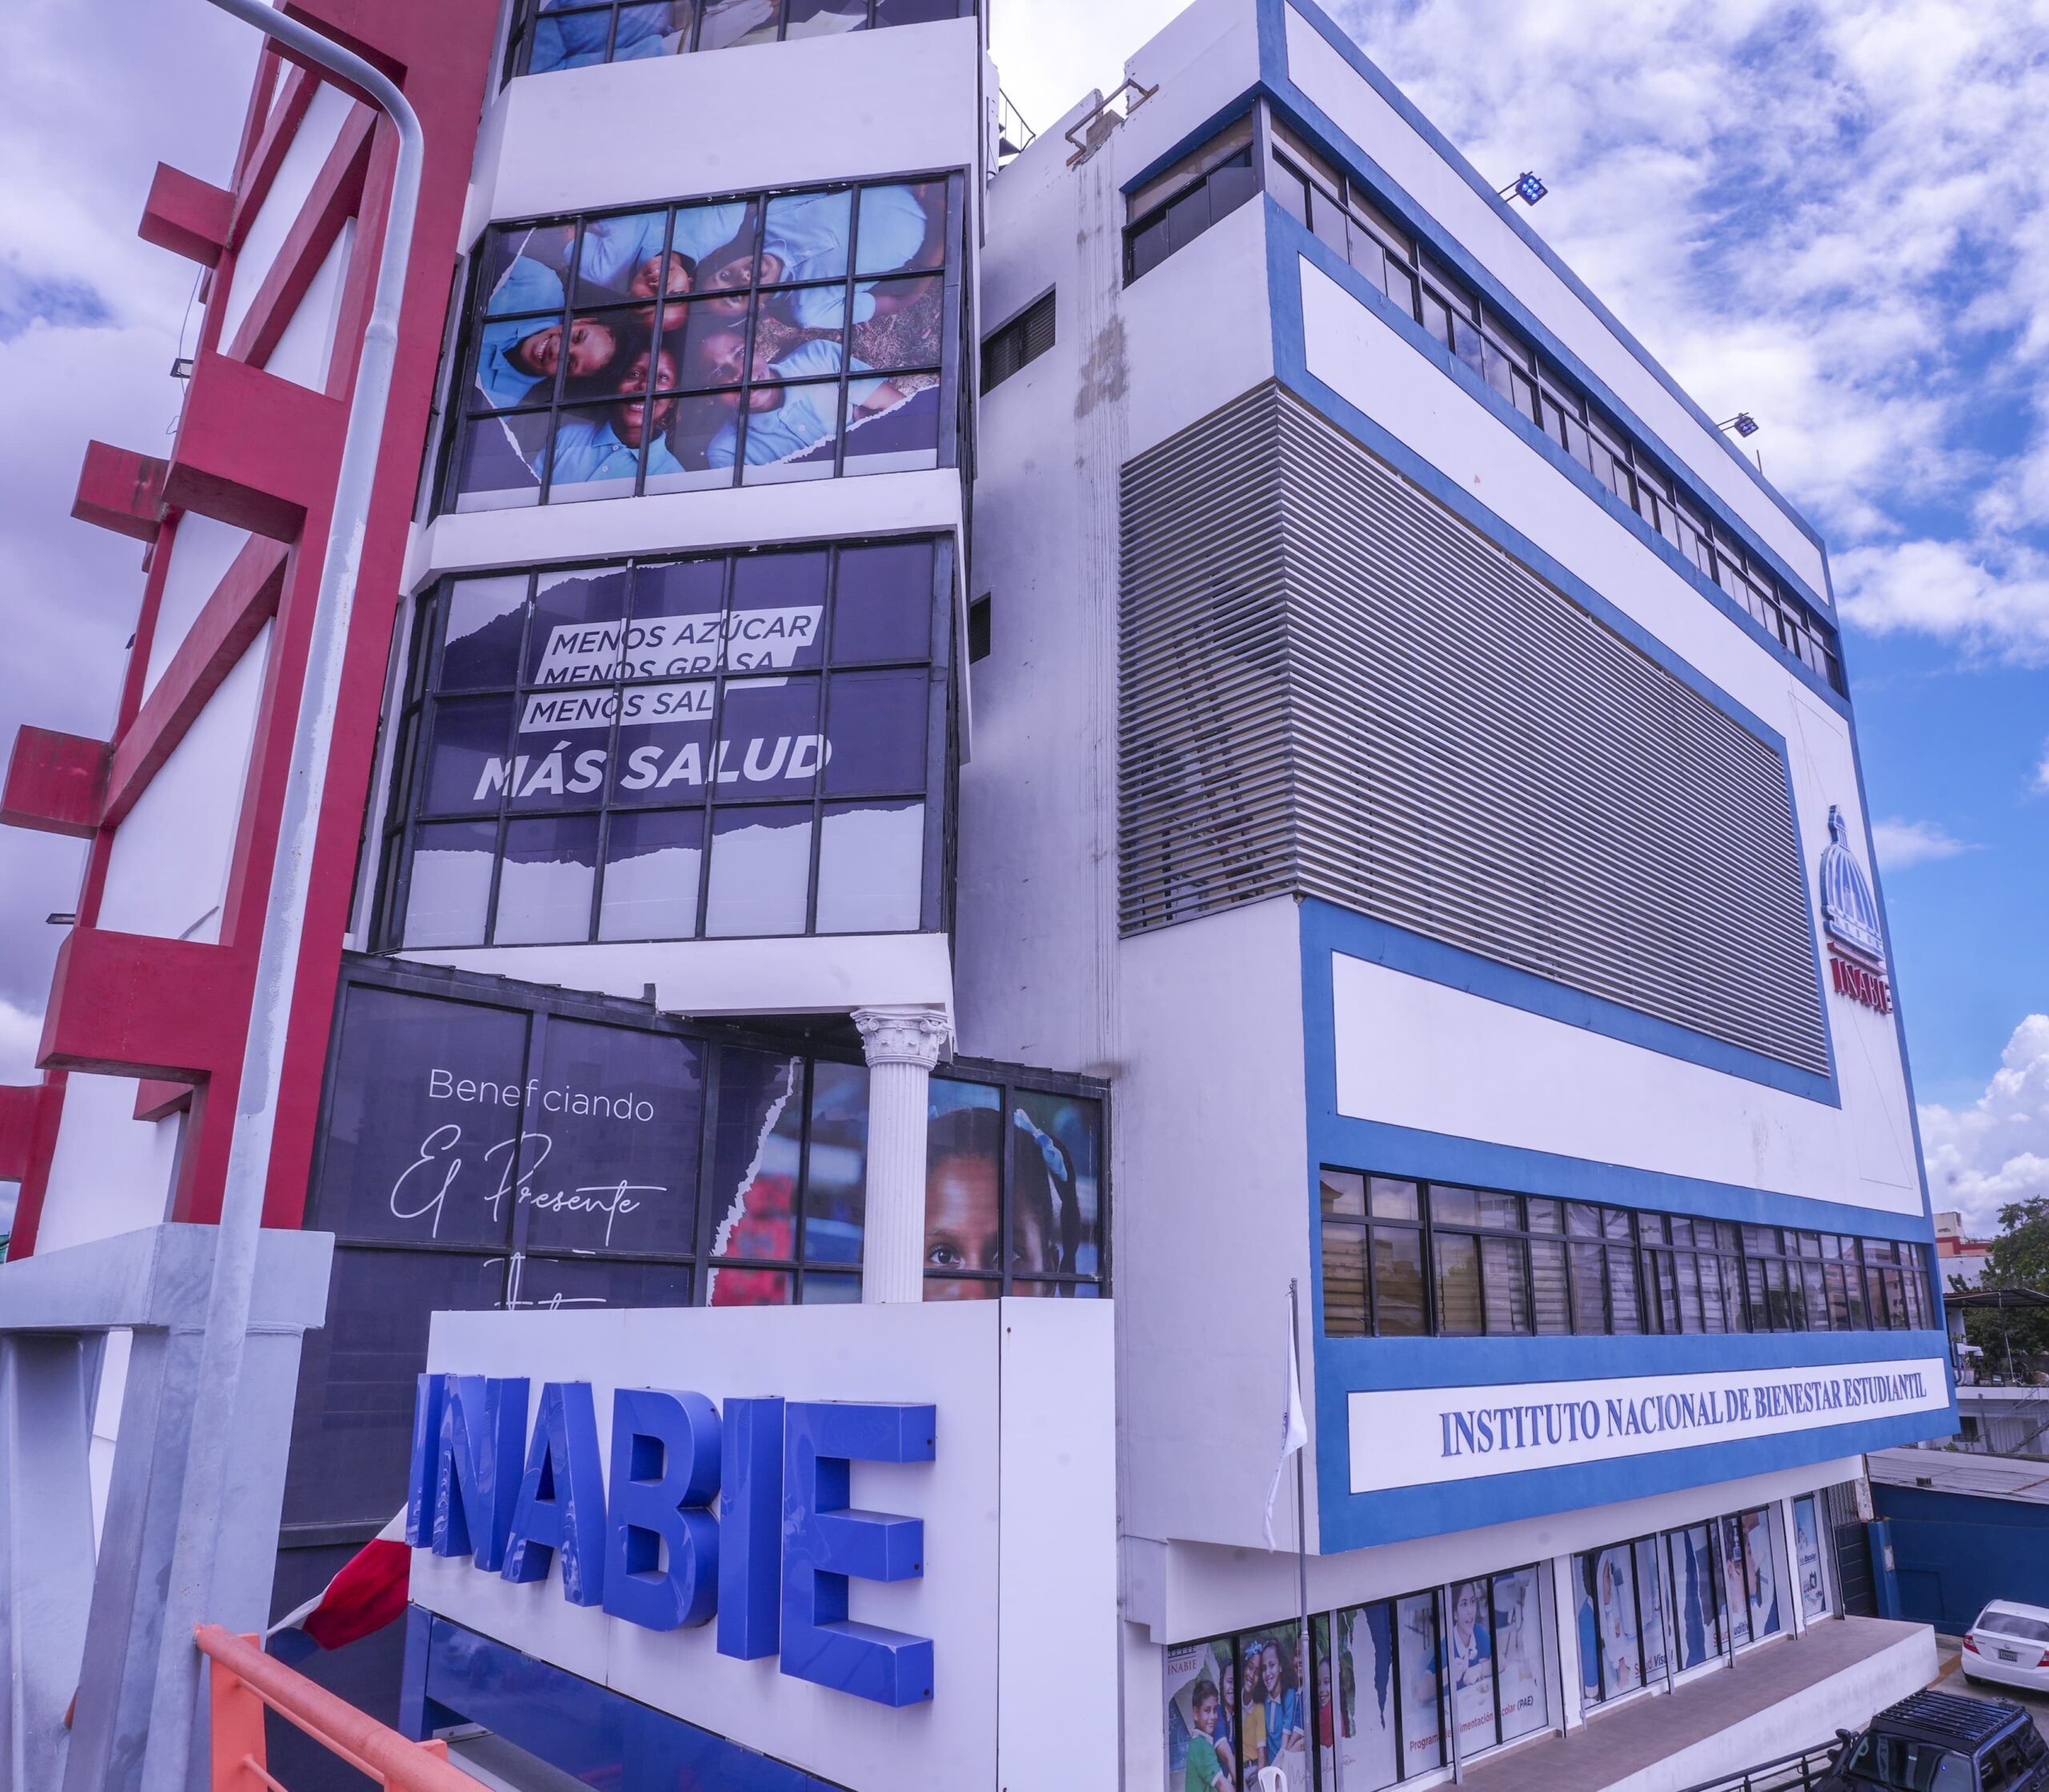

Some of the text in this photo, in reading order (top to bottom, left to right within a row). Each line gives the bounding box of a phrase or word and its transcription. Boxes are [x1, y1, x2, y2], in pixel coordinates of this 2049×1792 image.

[551, 614, 812, 655] MENOS AZÚCAR
[544, 660, 656, 684] MENOS
[529, 690, 712, 724] MENOS SAL
[473, 734, 832, 800] MÁS SALUD
[1830, 958, 1893, 1014] INABIE
[428, 1069, 654, 1121] Benefciando
[391, 1125, 667, 1247] El Presente
[1439, 1372, 1927, 1457] INSTITUTO NACIONAL DE BIENESTAR ESTUDIANTIL
[405, 1373, 936, 1707] INABIE
[1168, 1659, 1197, 1675] INABIE
[1409, 1734, 1439, 1751] Program
[1459, 1712, 1494, 1733] imentación
[1501, 1703, 1516, 1716] colar
[1517, 1695, 1534, 1711] (PAE)
